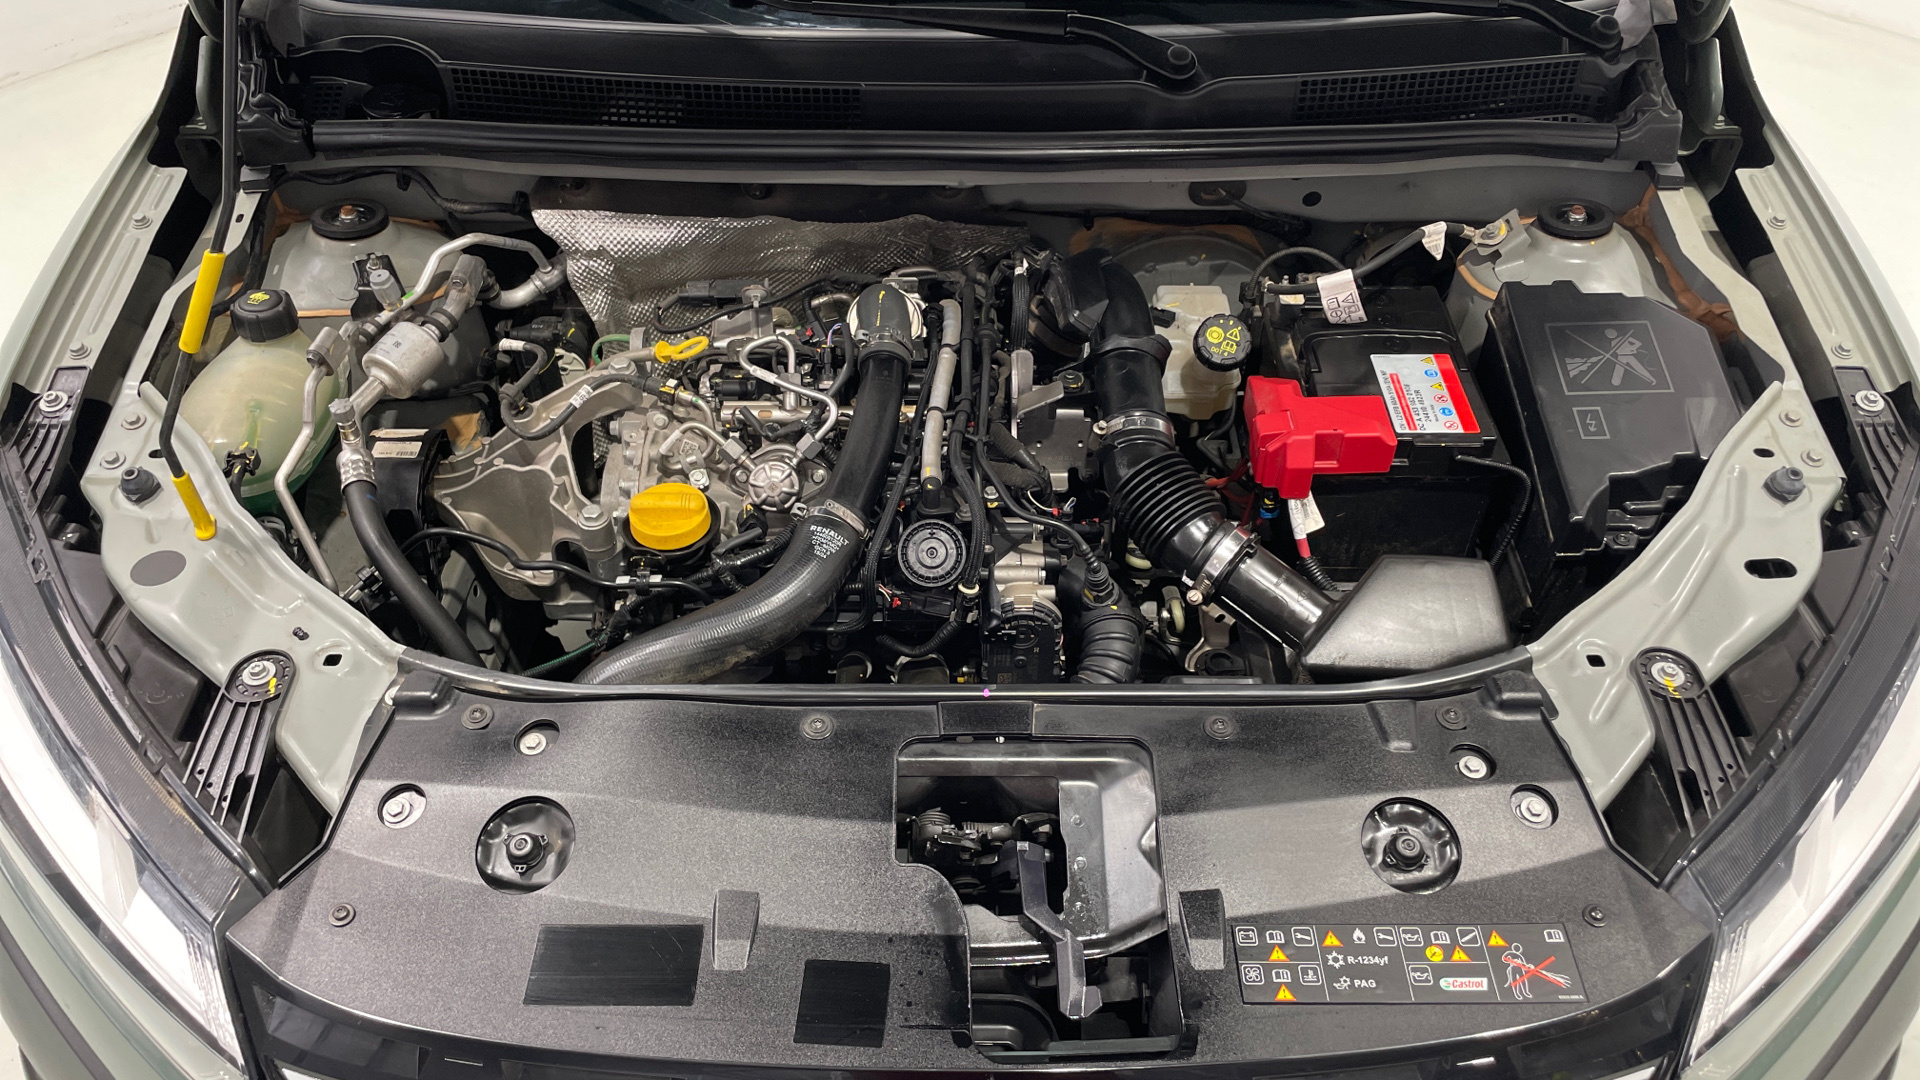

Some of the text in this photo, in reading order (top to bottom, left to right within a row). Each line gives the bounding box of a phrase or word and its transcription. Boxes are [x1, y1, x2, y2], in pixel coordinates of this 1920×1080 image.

[810, 525, 849, 545] RENAULT
[1347, 956, 1388, 966] R-1234yf
[1354, 979, 1376, 988] PAG
[1452, 979, 1484, 989] Castrol
